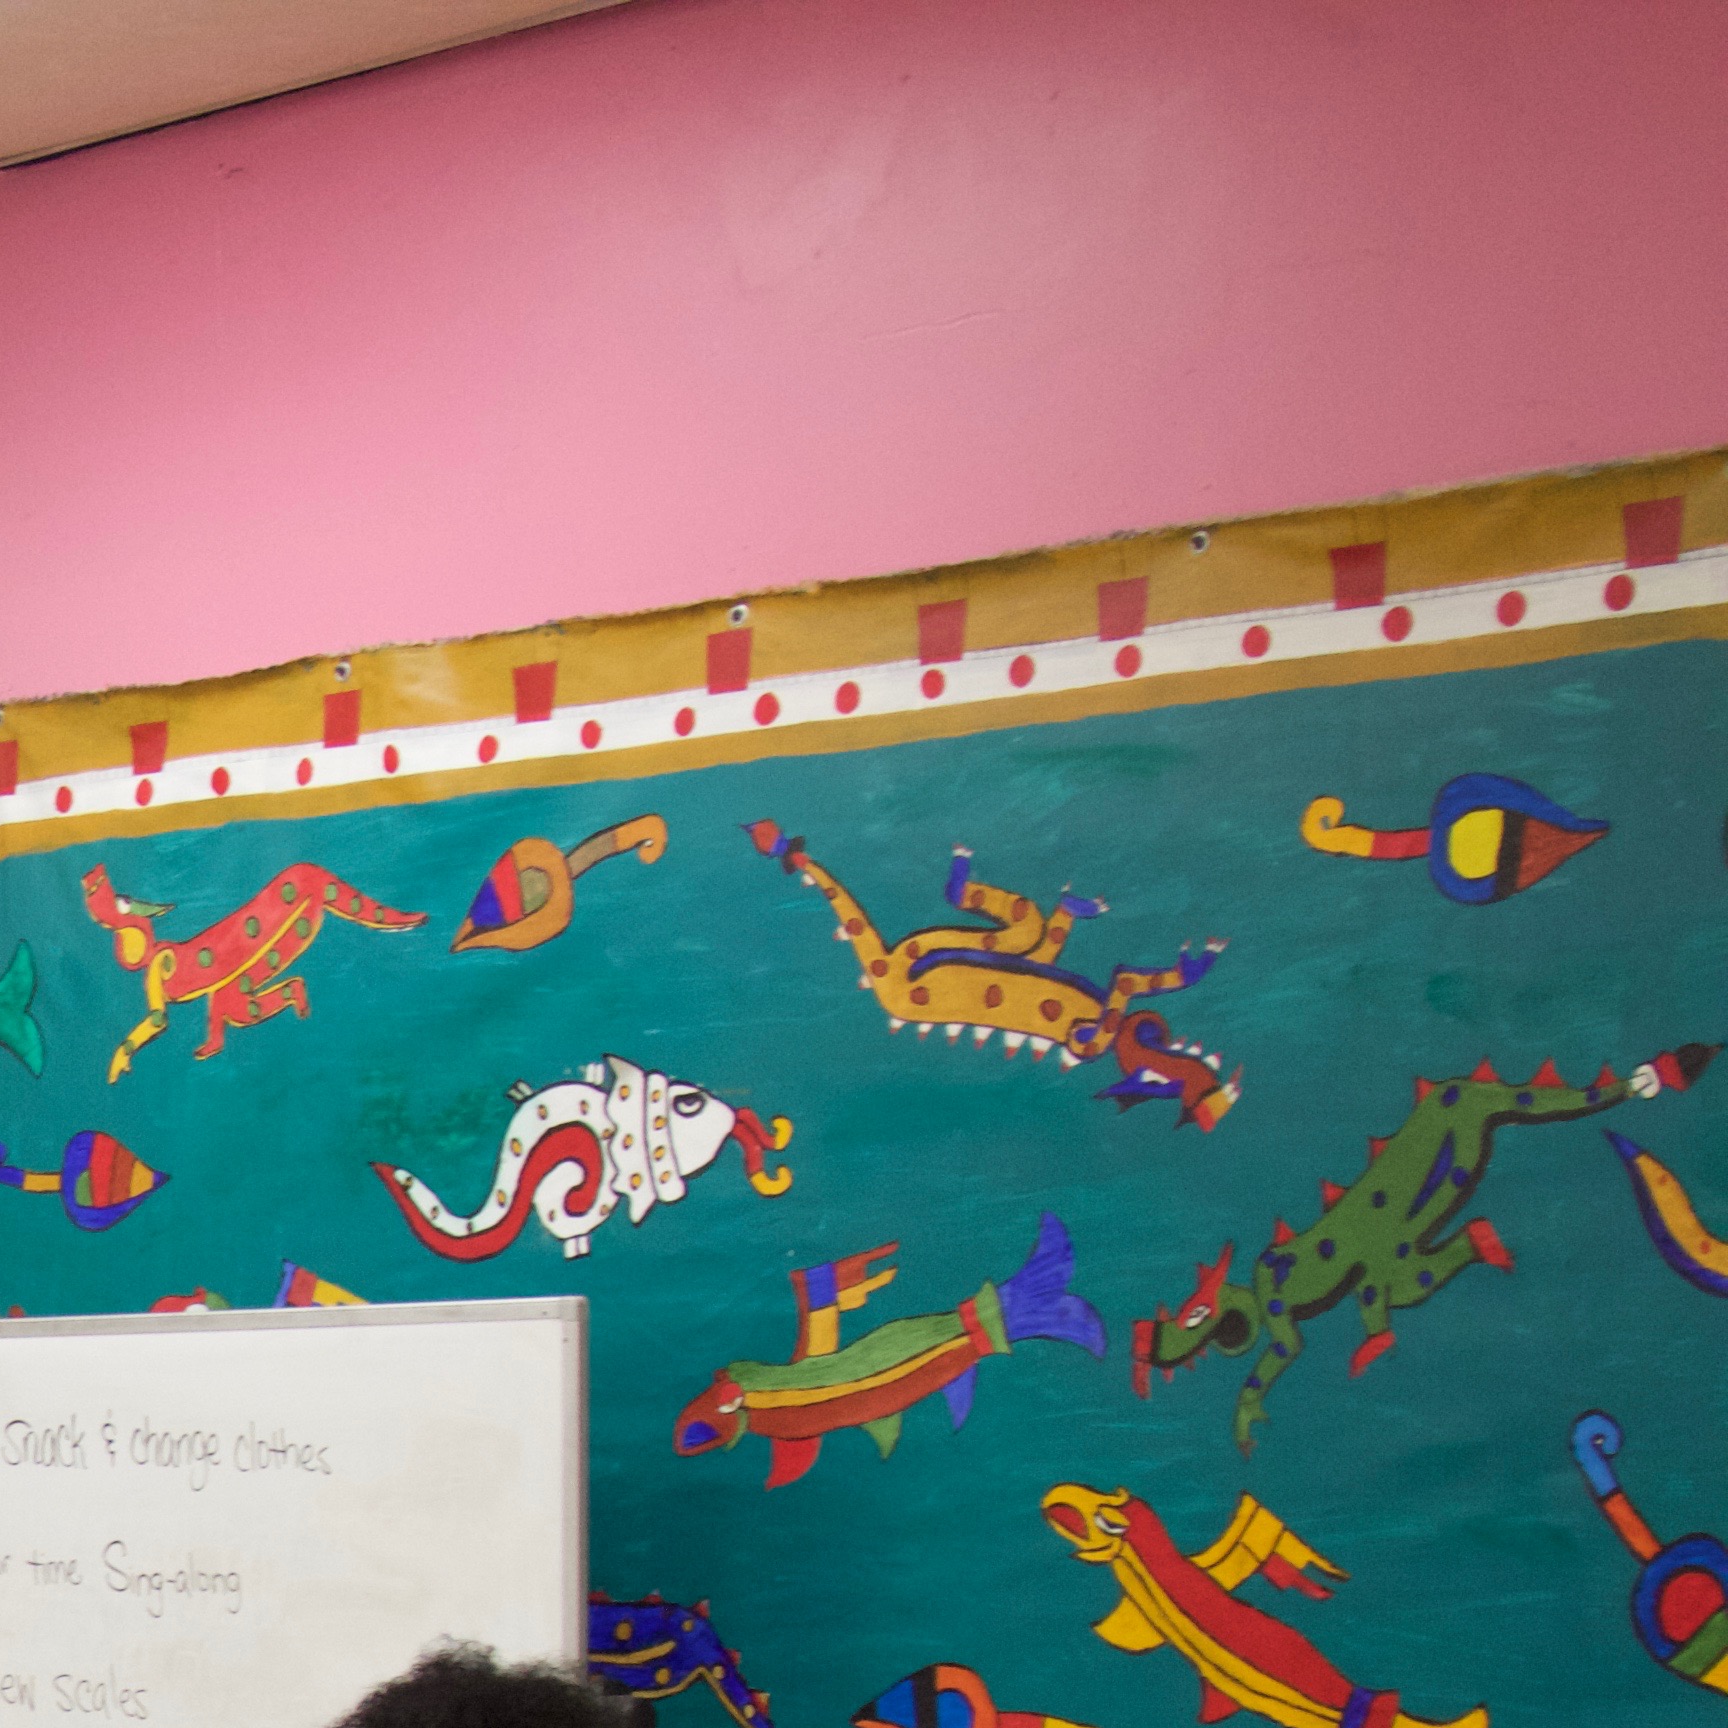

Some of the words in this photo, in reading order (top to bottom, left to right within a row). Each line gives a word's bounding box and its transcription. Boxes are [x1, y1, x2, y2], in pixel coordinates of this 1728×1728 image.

[130, 1416, 221, 1492] change
[233, 1421, 333, 1476] clothes
[27, 1550, 83, 1586] time
[102, 1539, 242, 1619] Sing-along
